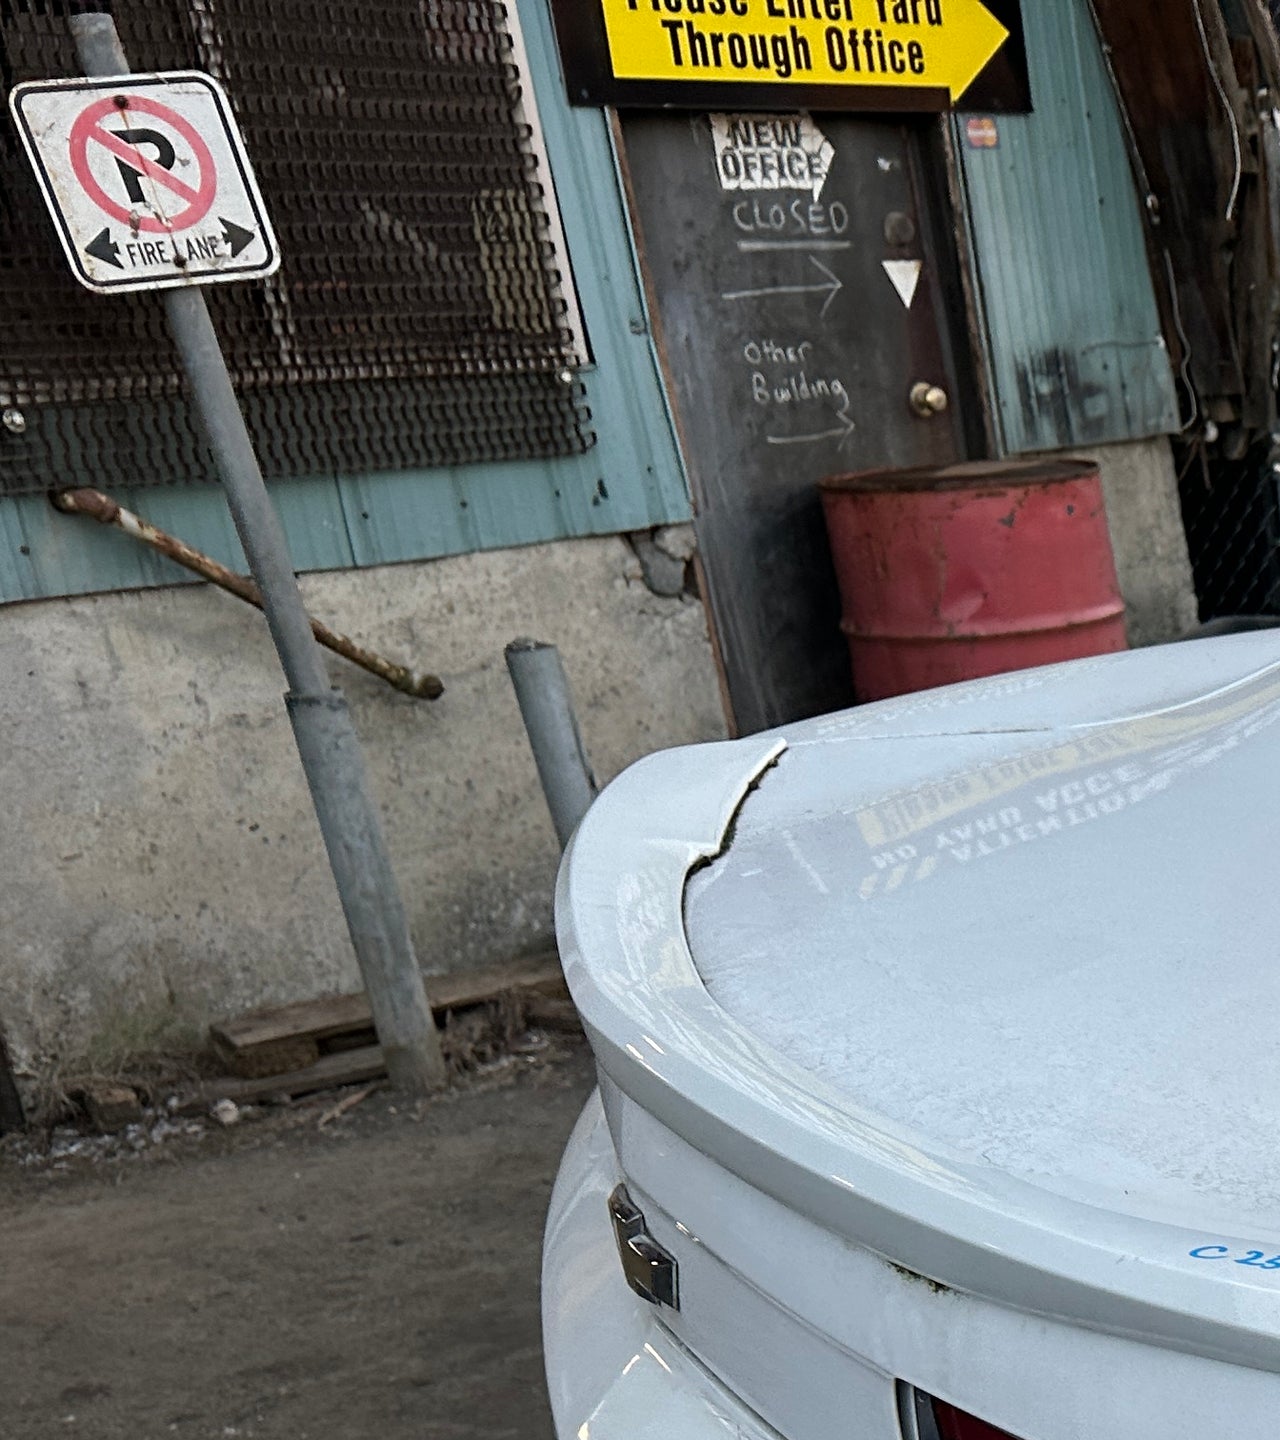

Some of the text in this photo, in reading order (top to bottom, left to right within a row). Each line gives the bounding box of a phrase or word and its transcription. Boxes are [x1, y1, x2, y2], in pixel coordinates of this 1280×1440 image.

[661, 20, 926, 78] Through Office
[726, 119, 800, 148] NEW
[720, 148, 827, 181] OFFICE
[732, 200, 849, 234] CLOSED
[126, 241, 171, 268] FIRE
[744, 340, 813, 365] Other
[752, 371, 850, 414] Building
